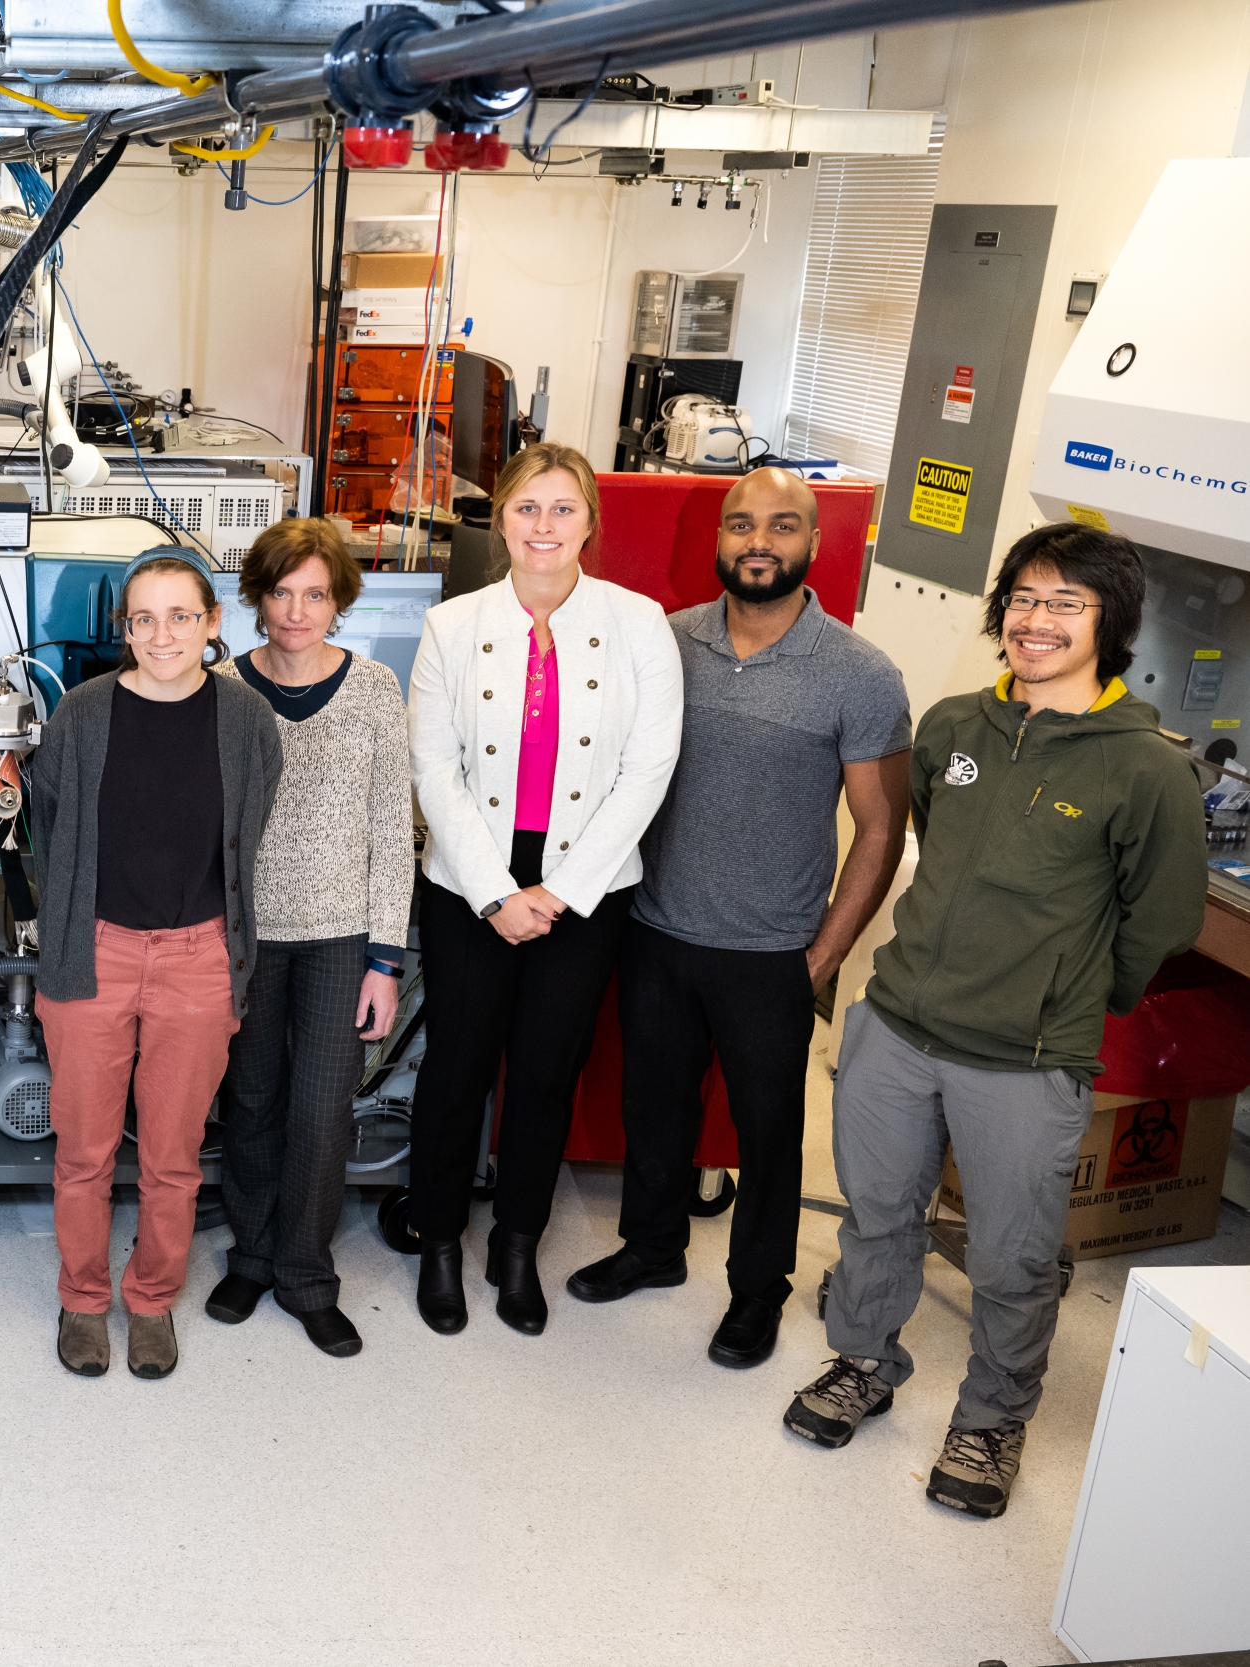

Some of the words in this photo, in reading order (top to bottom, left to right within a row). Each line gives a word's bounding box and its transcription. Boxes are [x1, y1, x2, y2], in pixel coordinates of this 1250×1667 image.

[359, 310, 381, 318] FedEx
[356, 329, 377, 337] FedEx
[920, 465, 969, 492] CAUTION
[1070, 449, 1108, 464] BAKER
[1113, 457, 1248, 494] BioChemG
[916, 496, 935, 506] ELECTRICAL
[936, 501, 946, 509] PANEL
[923, 506, 934, 514] CLEAR
[933, 517, 956, 528] REGULATIONS
[1053, 801, 1083, 818] OR
[1111, 1163, 1173, 1184] BIOHAZARD
[1116, 1185, 1151, 1201] MEDICAL
[1155, 1178, 1185, 1194] WASTE,
[1119, 1202, 1131, 1213] UN
[1133, 1198, 1154, 1211] 3291
[1079, 1234, 1120, 1250] MAXIMUM
[1122, 1229, 1153, 1243] WEIGHT
[1156, 1227, 1165, 1237] 55
[1167, 1223, 1182, 1235] LBS
